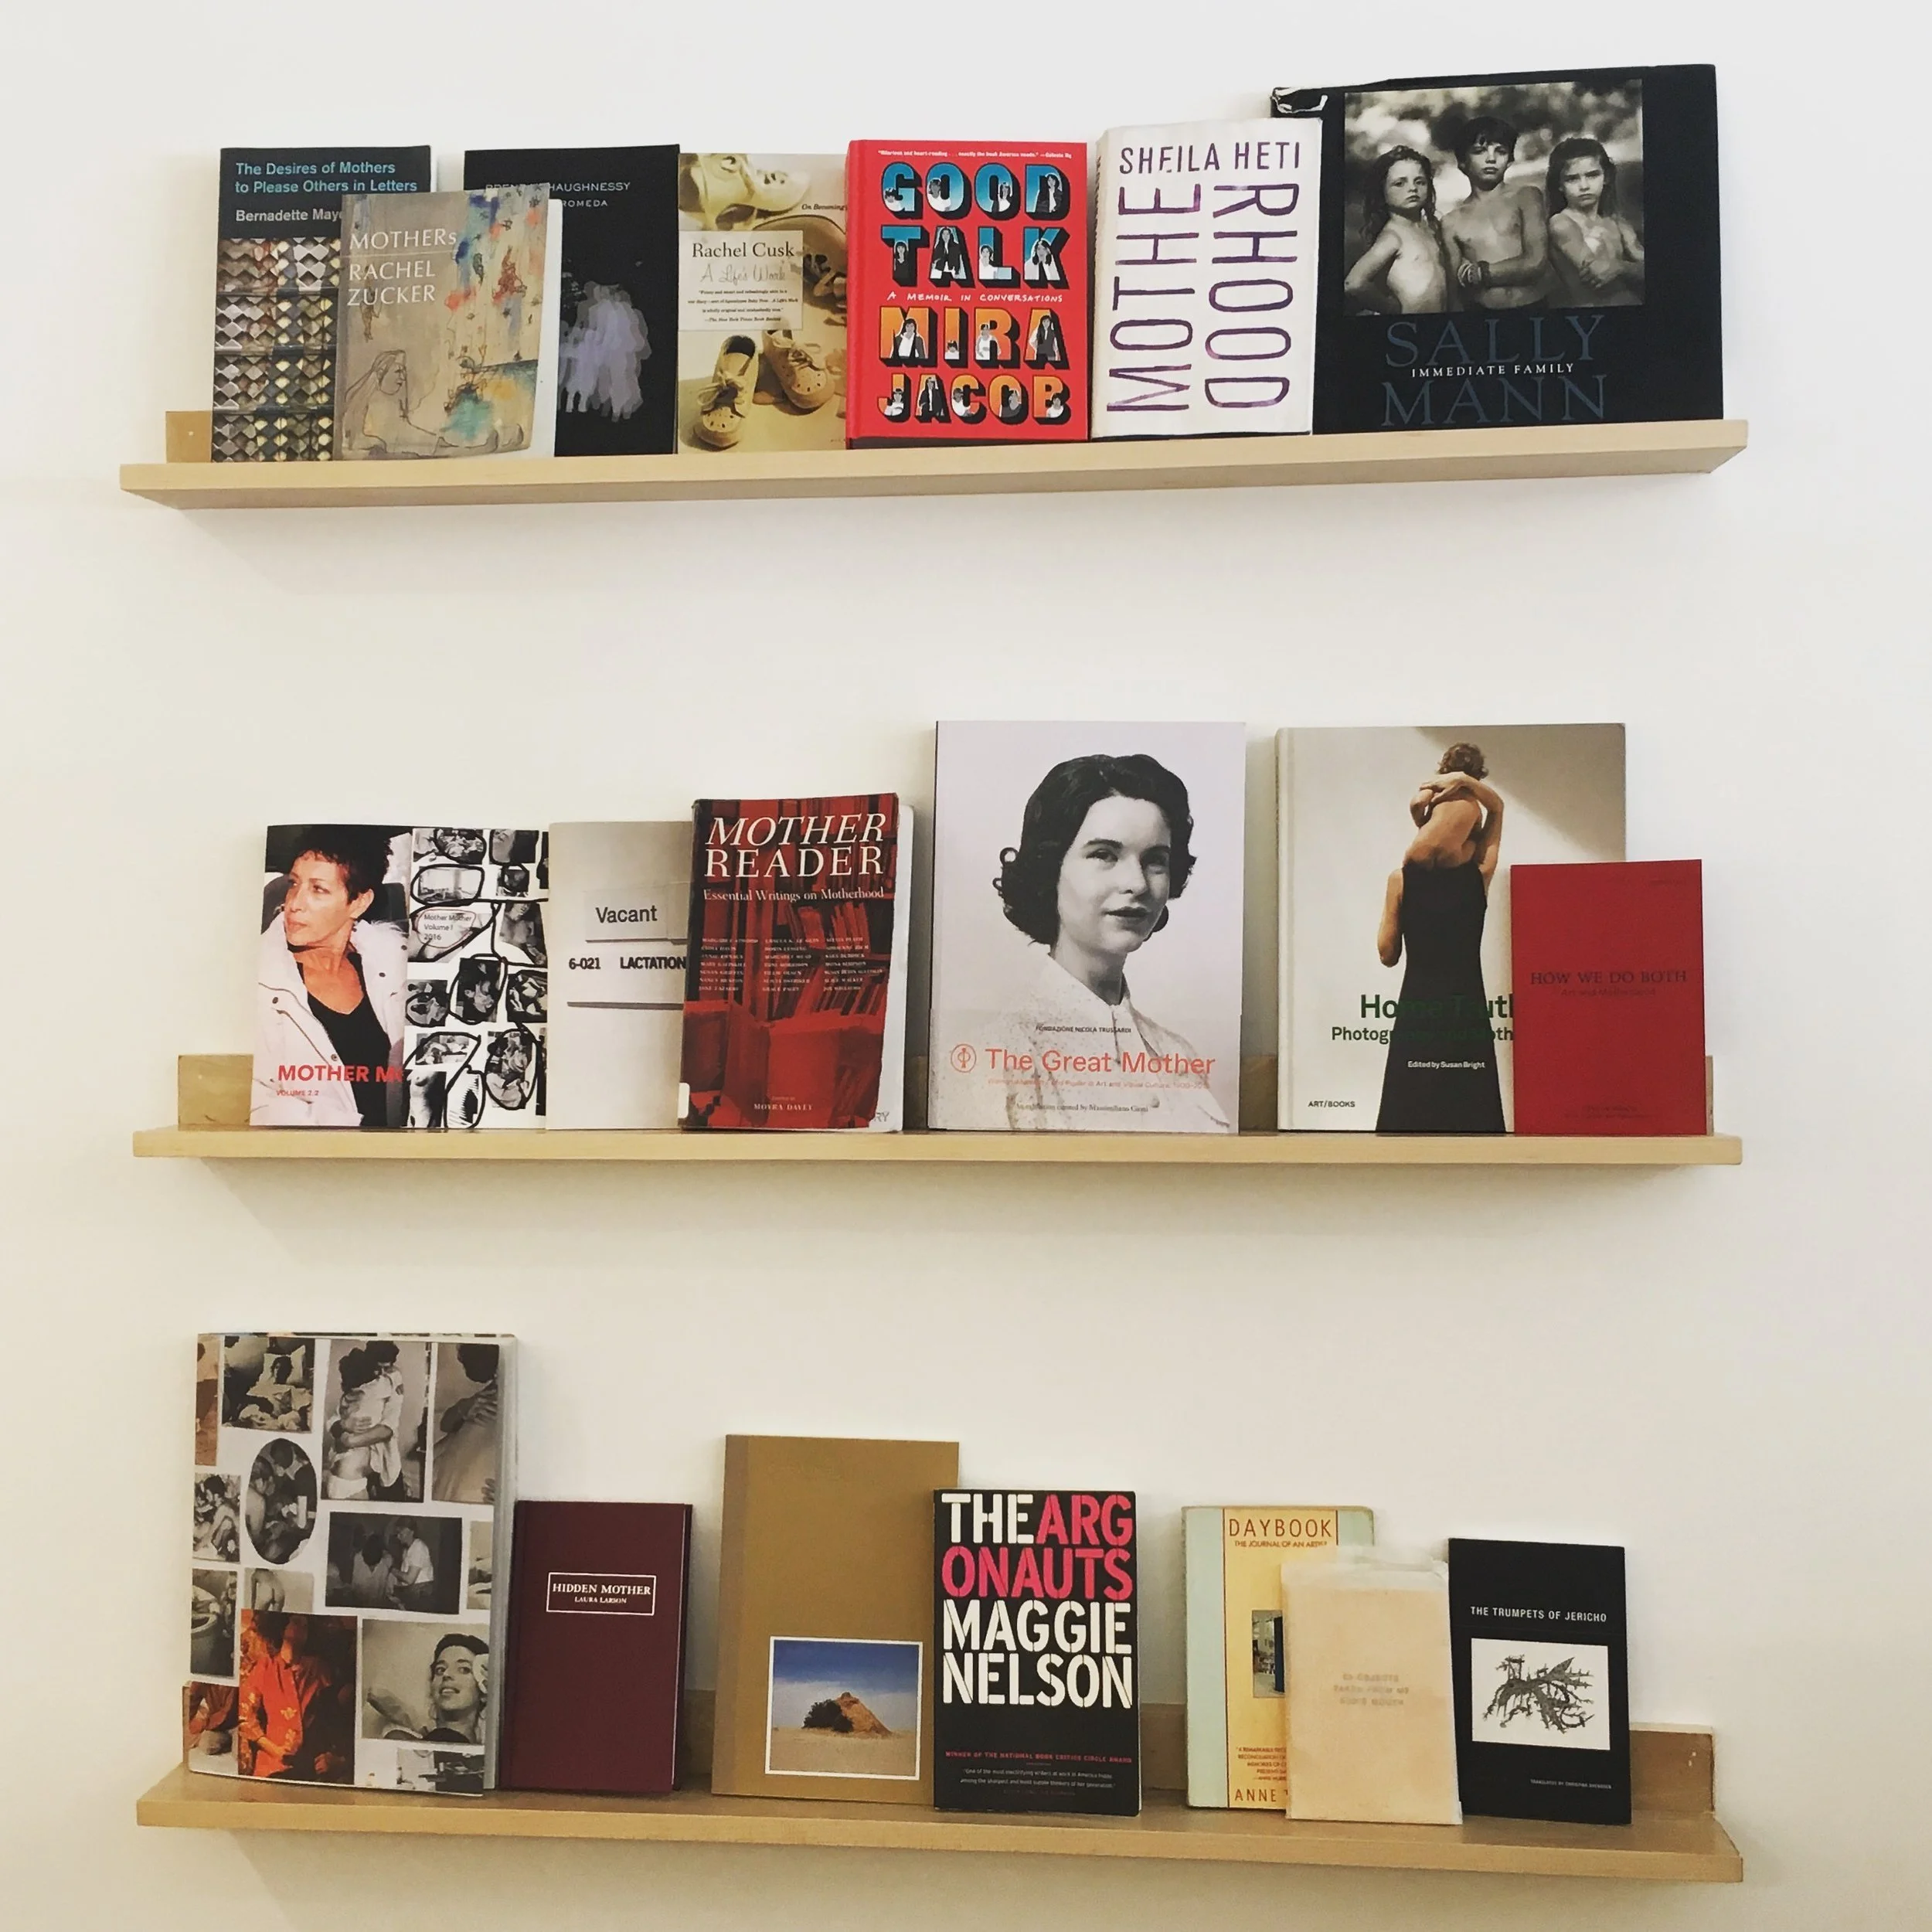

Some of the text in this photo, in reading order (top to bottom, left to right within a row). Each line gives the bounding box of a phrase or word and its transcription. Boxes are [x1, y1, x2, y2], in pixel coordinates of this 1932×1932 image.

[236, 161, 396, 175] The Desires of Mothers
[1119, 141, 1300, 175] SHEILA HETI
[235, 179, 417, 193] to Please Others in Letters
[881, 162, 1070, 220] GOOD
[236, 209, 308, 222] Bernadette
[349, 229, 457, 250] MOTHERs
[692, 241, 794, 258] Rachel Cusk
[881, 225, 1070, 289] TALK
[349, 260, 437, 281] RACHEL
[347, 284, 436, 306] ZUCKER
[887, 291, 897, 301] A
[907, 293, 952, 302] MEMOIR
[1107, 183, 1201, 412] MOTHE
[1205, 183, 1299, 408] RHOOD
[879, 306, 1070, 369] MIRA
[1386, 315, 1605, 368] SALLY
[1411, 363, 1573, 378] IMMEDIATE FAMILY
[877, 373, 1071, 425] JACOB
[1381, 375, 1607, 427] MANN
[705, 813, 886, 846] MOTHER
[704, 846, 884, 878] READER
[704, 886, 884, 903] Essential Writings on Motherhood
[596, 906, 657, 923] Vacant
[569, 956, 686, 970] 6-021 LACTATION
[1531, 970, 1687, 985] HOW WE DO BOTH
[985, 1049, 1216, 1074] The Great Mother
[1463, 1061, 1485, 1070] Bright
[278, 1064, 369, 1082] MOTHER
[941, 1493, 1133, 1546] THE ARG
[1229, 1519, 1332, 1537] DAYBOOK
[941, 1546, 1133, 1600] ONAUTS
[553, 1583, 651, 1595] HIDDEN MOTHER
[1471, 1607, 1607, 1622] THE TRUMPETS OF JERICHO
[943, 1599, 1132, 1654] MAGGIE
[943, 1652, 1133, 1709] NELSON
[1235, 1789, 1276, 1801] ANNE
